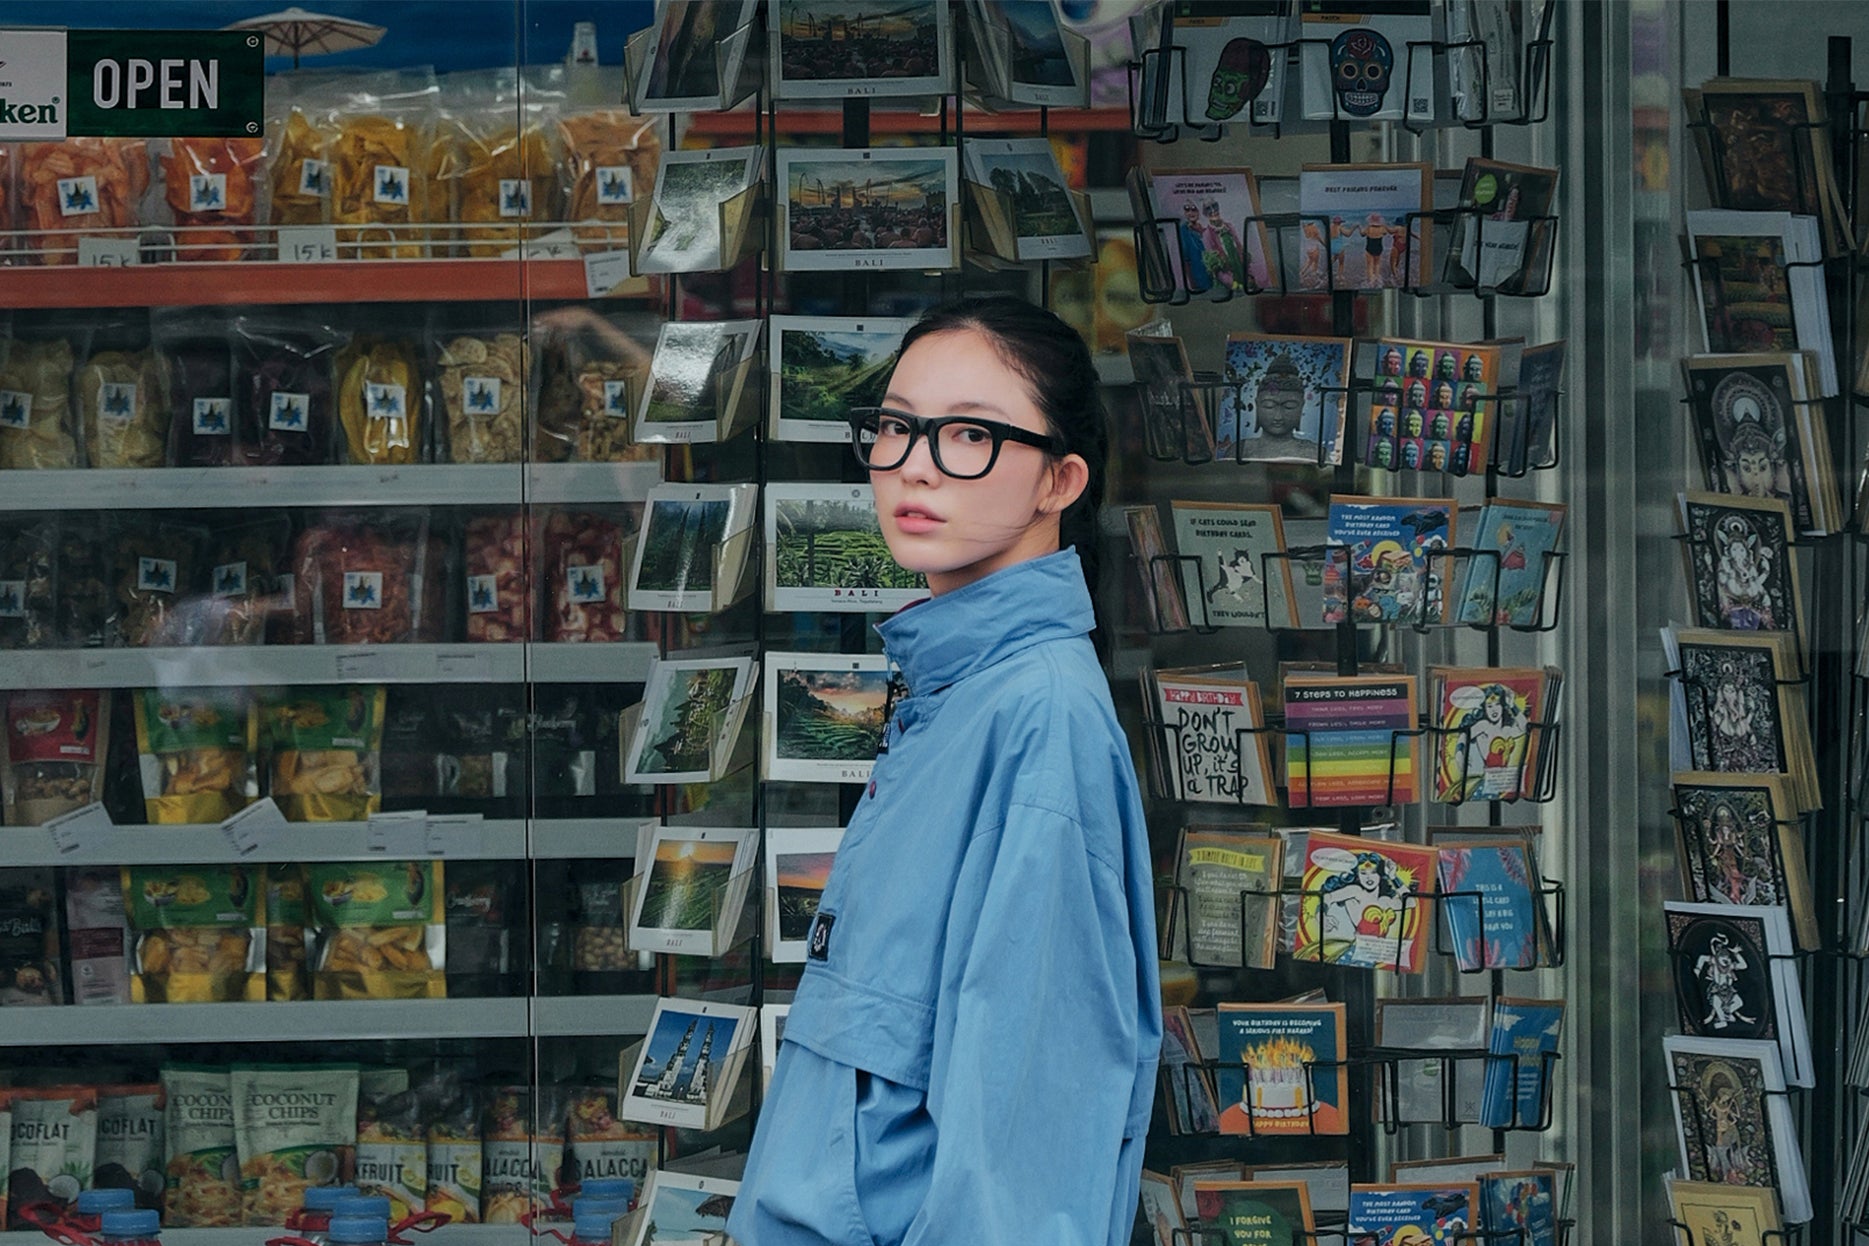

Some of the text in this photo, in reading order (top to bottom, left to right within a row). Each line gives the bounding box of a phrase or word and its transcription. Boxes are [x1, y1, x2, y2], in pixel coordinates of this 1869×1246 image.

[94, 59, 219, 109] OPEN
[855, 259, 884, 267] BALI
[834, 589, 879, 597] BALI
[1294, 691, 1301, 699] 7
[1333, 690, 1346, 698] TO
[1178, 706, 1235, 735] DON'T
[1182, 732, 1240, 755] GROW
[841, 770, 870, 778] BALI
[1205, 775, 1249, 798] TRAP
[1232, 1019, 1250, 1027] YOUR
[1250, 1019, 1281, 1027] BIRTHDAY
[251, 1093, 338, 1106] COCONUT
[268, 1106, 320, 1119] CHIPS
[1234, 1215, 1272, 1226] FORGIVE
[1233, 1229, 1272, 1239] YOU FOR
